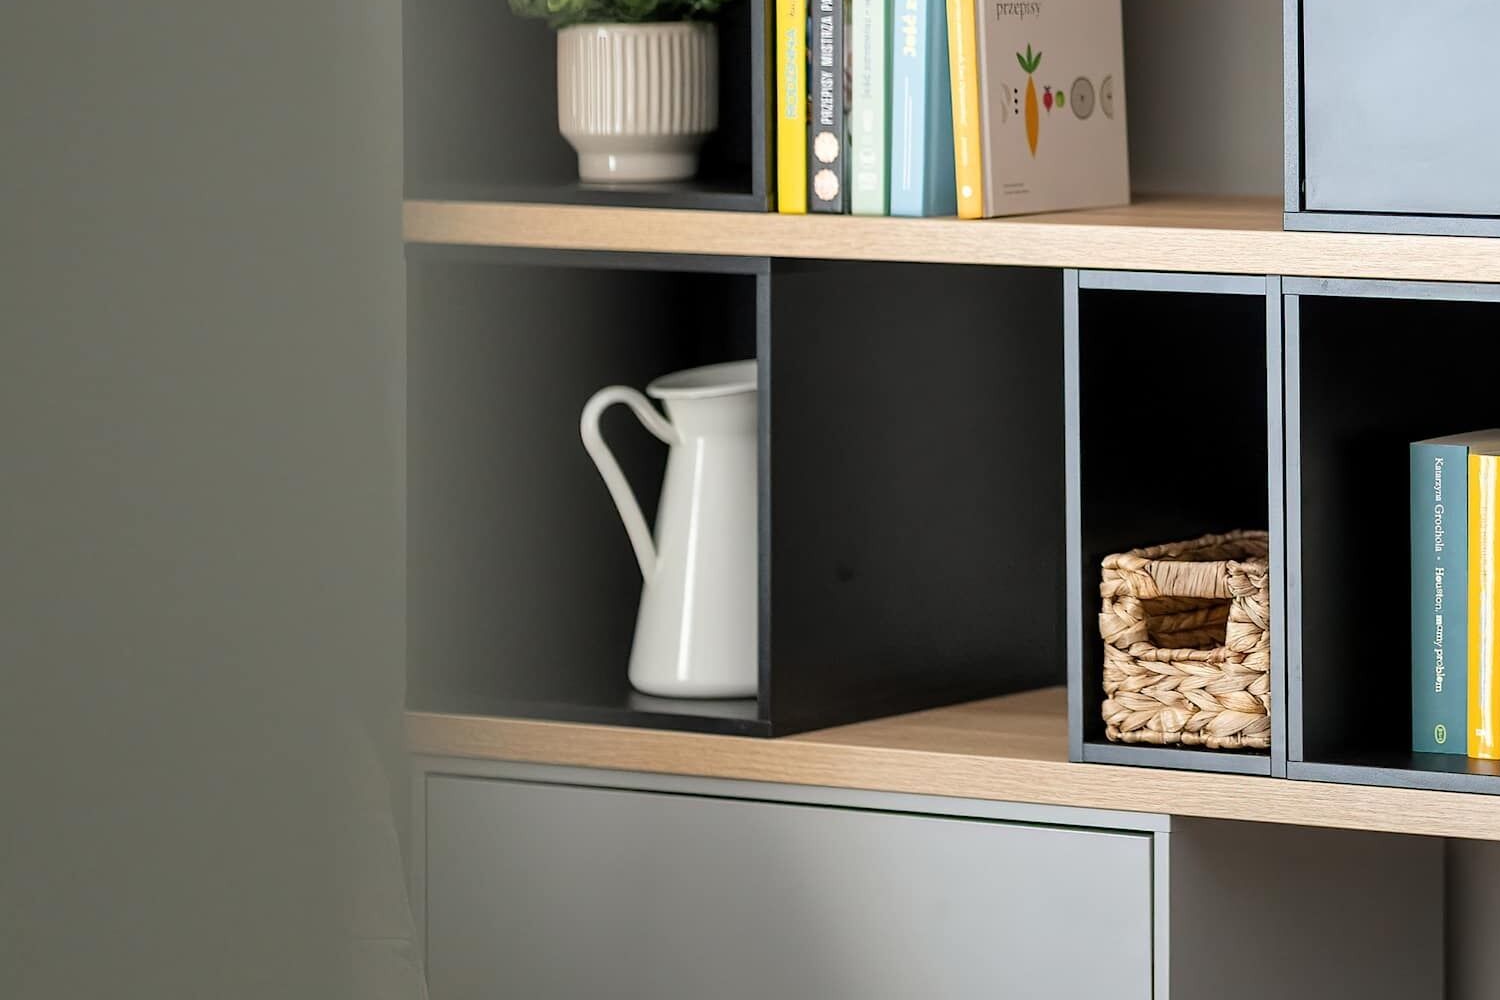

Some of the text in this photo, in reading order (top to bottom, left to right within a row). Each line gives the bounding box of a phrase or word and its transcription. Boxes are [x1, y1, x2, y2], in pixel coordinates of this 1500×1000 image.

[820, 15, 834, 67] MISTRZA
[820, 71, 834, 126] PRZEPISY
[1433, 456, 1446, 693] Katarzyna Grochola Houston, mamy problem
